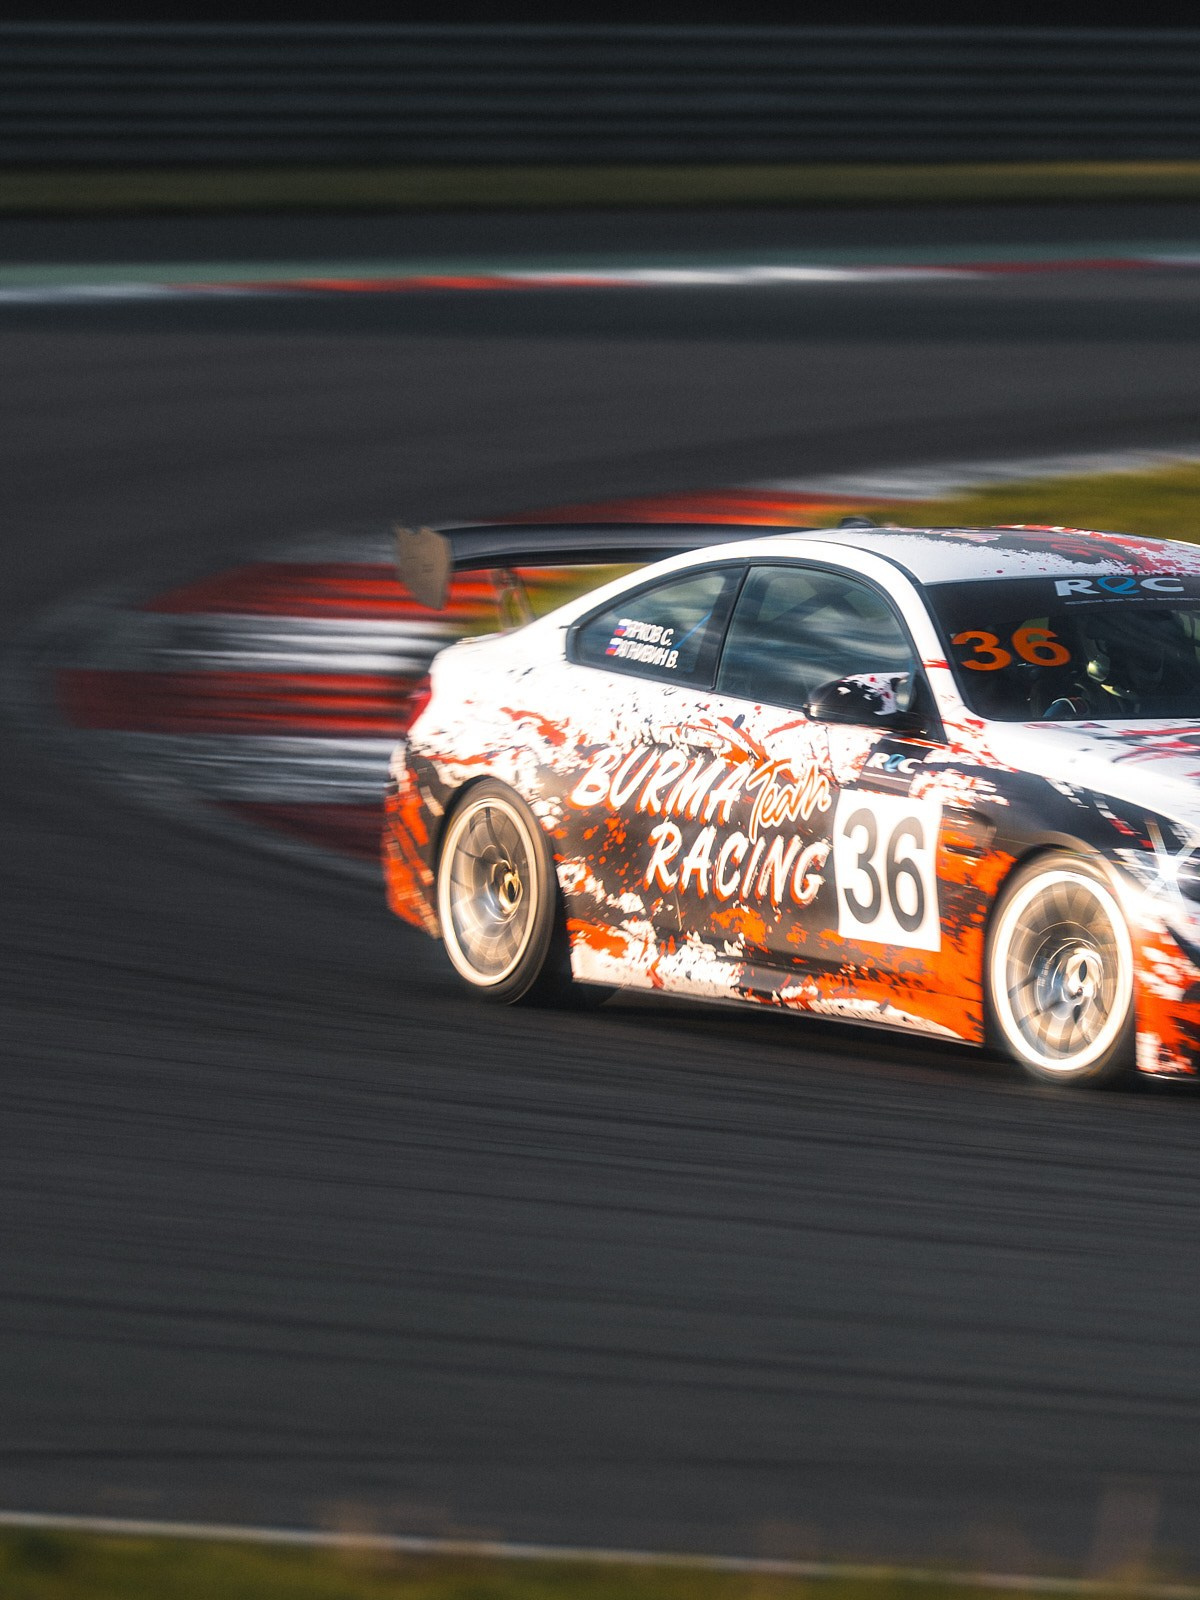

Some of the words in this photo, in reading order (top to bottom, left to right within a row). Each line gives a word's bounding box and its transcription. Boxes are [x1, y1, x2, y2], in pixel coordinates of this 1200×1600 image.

[951, 627, 1071, 671] 36
[569, 744, 754, 824] BURMA
[745, 757, 833, 844] Team
[644, 818, 834, 907] RACING
[842, 807, 926, 934] 36
